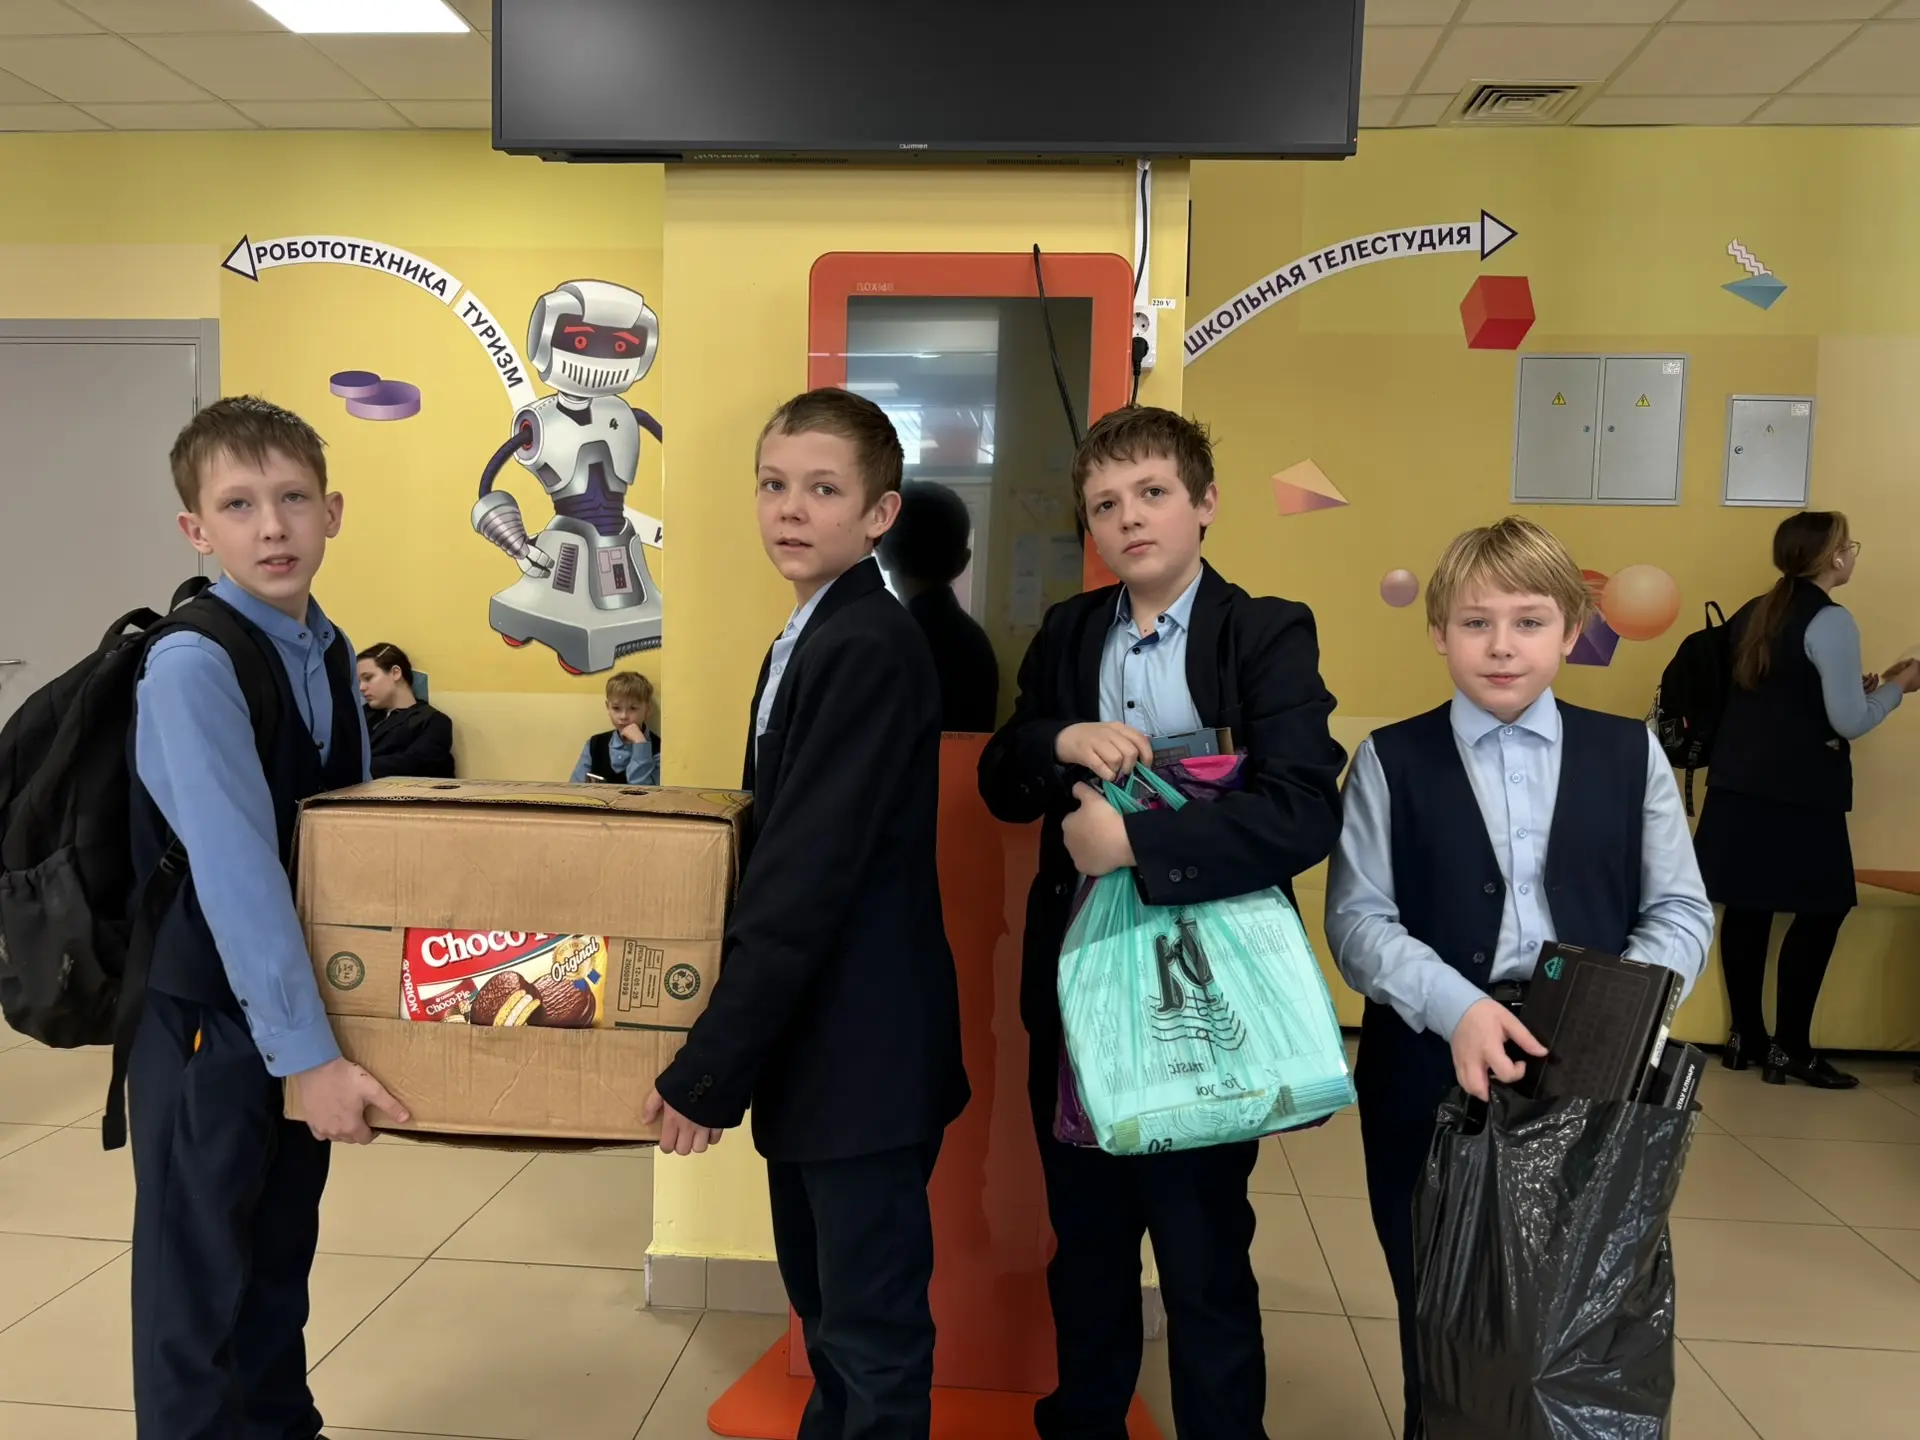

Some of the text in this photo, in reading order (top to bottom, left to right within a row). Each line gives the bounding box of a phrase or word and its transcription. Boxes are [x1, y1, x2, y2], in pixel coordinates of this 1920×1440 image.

[255, 240, 448, 297] РОБОТОТЕХНИКА
[1183, 225, 1471, 356] ШКОЛЬНАЯ ТЕЛЕСТУДИЯ
[461, 301, 523, 388] ТУРИЗМ
[421, 930, 549, 968] Choco
[551, 935, 600, 982] Original
[403, 972, 418, 1012] ORION
